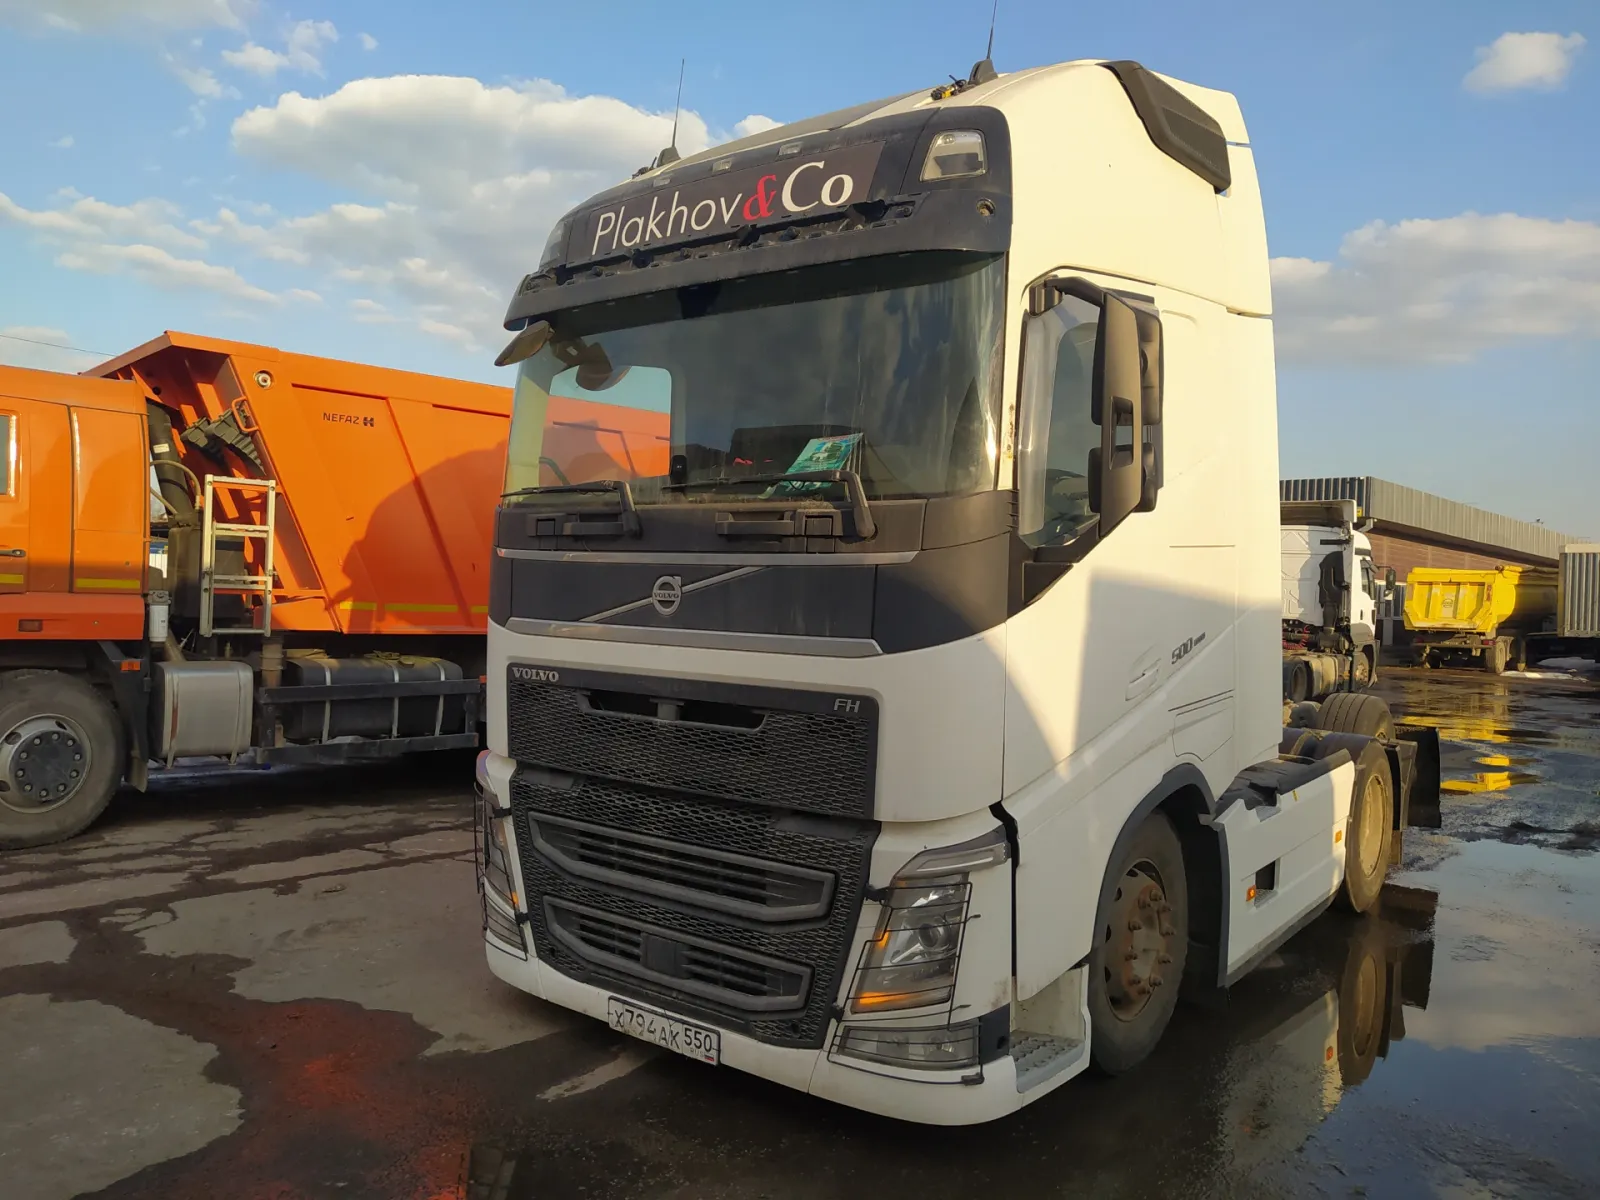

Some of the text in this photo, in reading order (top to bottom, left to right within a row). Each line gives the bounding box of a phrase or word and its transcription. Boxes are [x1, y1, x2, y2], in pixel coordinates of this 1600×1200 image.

[592, 160, 854, 255] Plakhov&Co
[323, 412, 360, 425] NEFAZ
[1171, 637, 1193, 665] 500
[512, 667, 559, 682] VOLVO
[833, 698, 861, 713] FH
[684, 1027, 712, 1052] 550
